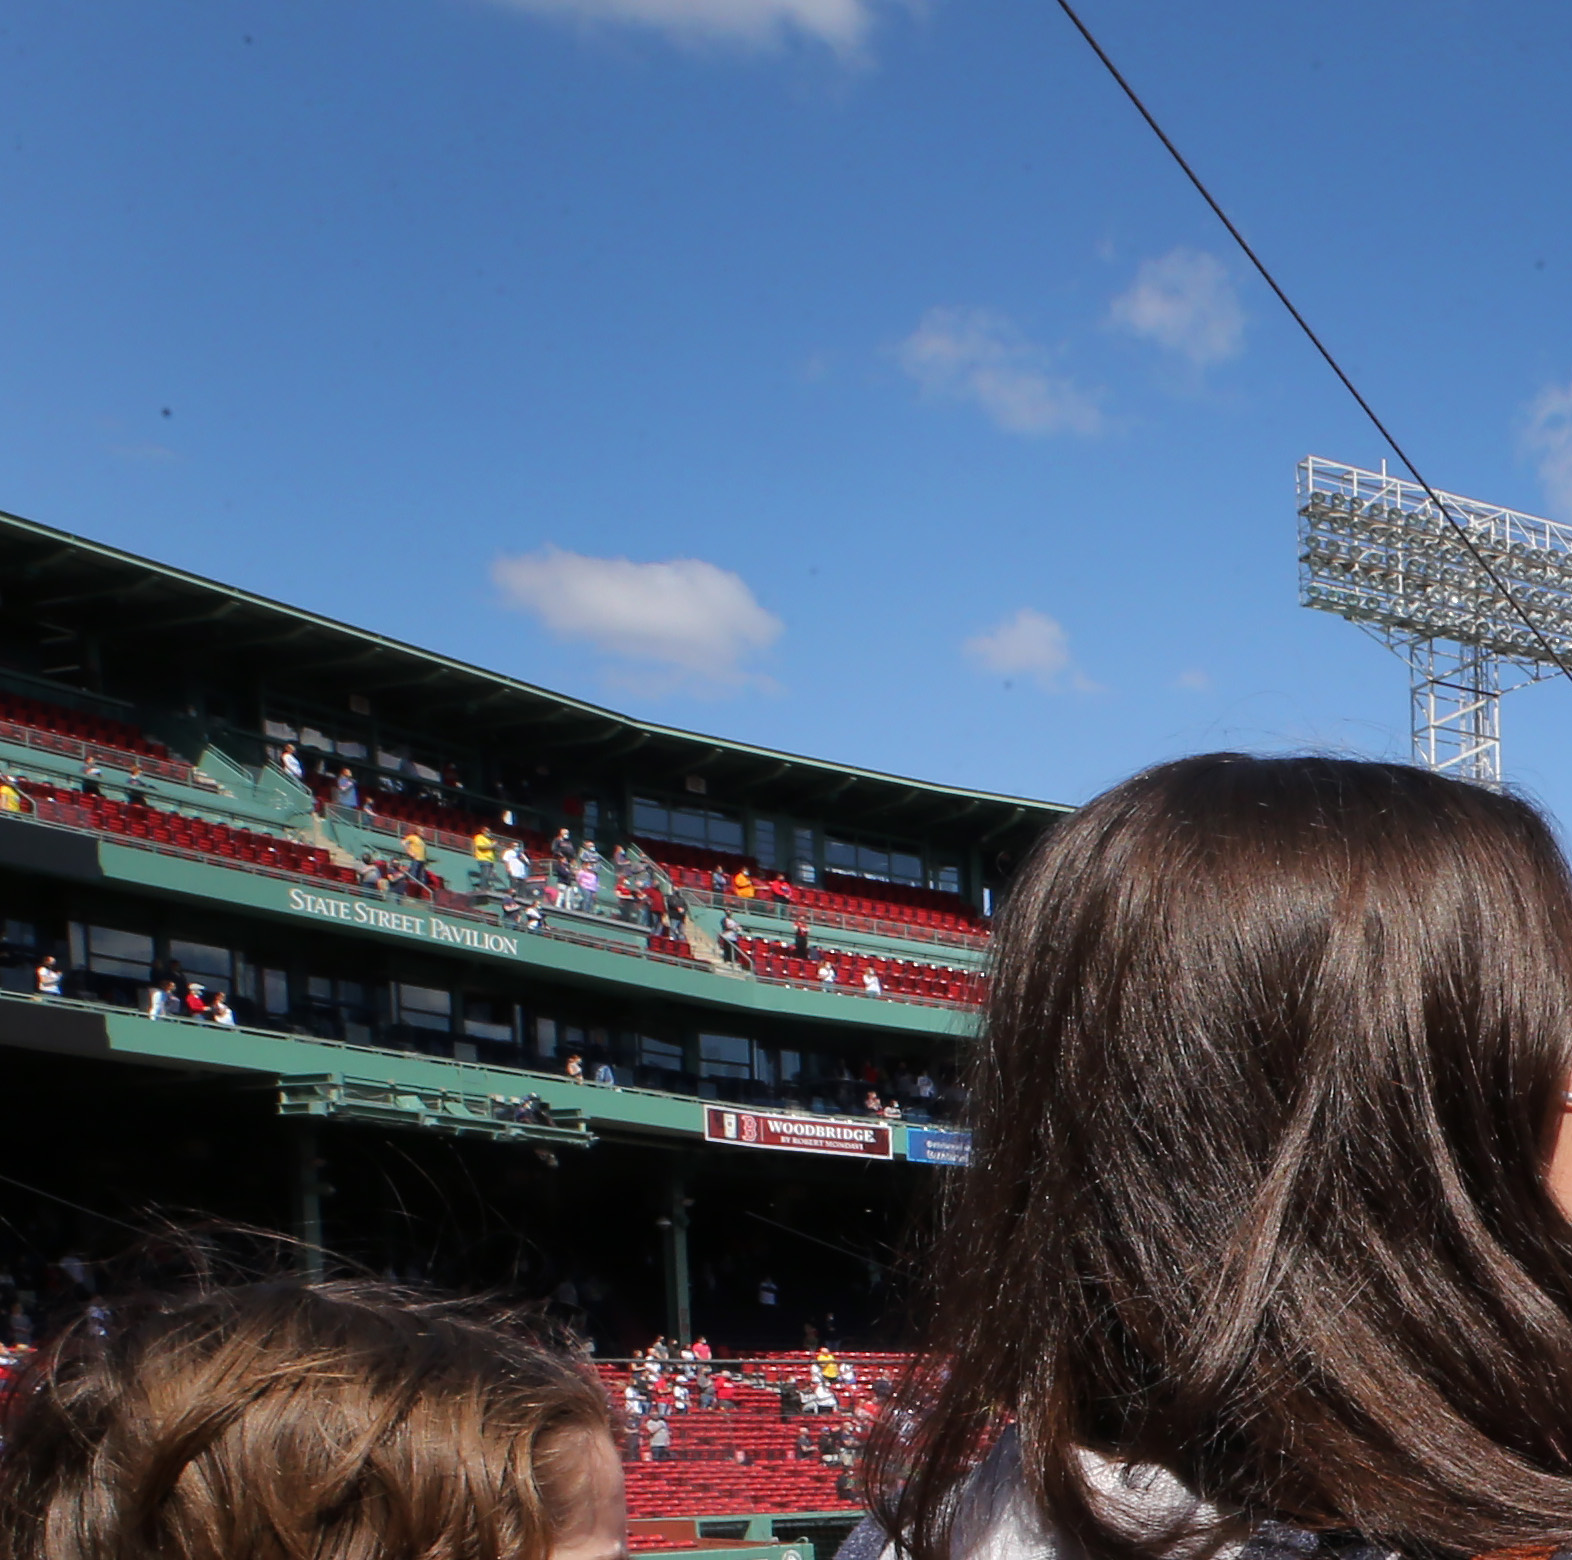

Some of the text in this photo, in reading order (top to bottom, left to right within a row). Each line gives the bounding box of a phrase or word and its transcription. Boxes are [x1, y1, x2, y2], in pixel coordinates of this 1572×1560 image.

[289, 888, 518, 955] STATE STREET PAVILION
[767, 1119, 877, 1143] WOODBRIDGE
[792, 1137, 825, 1147] ROBERT
